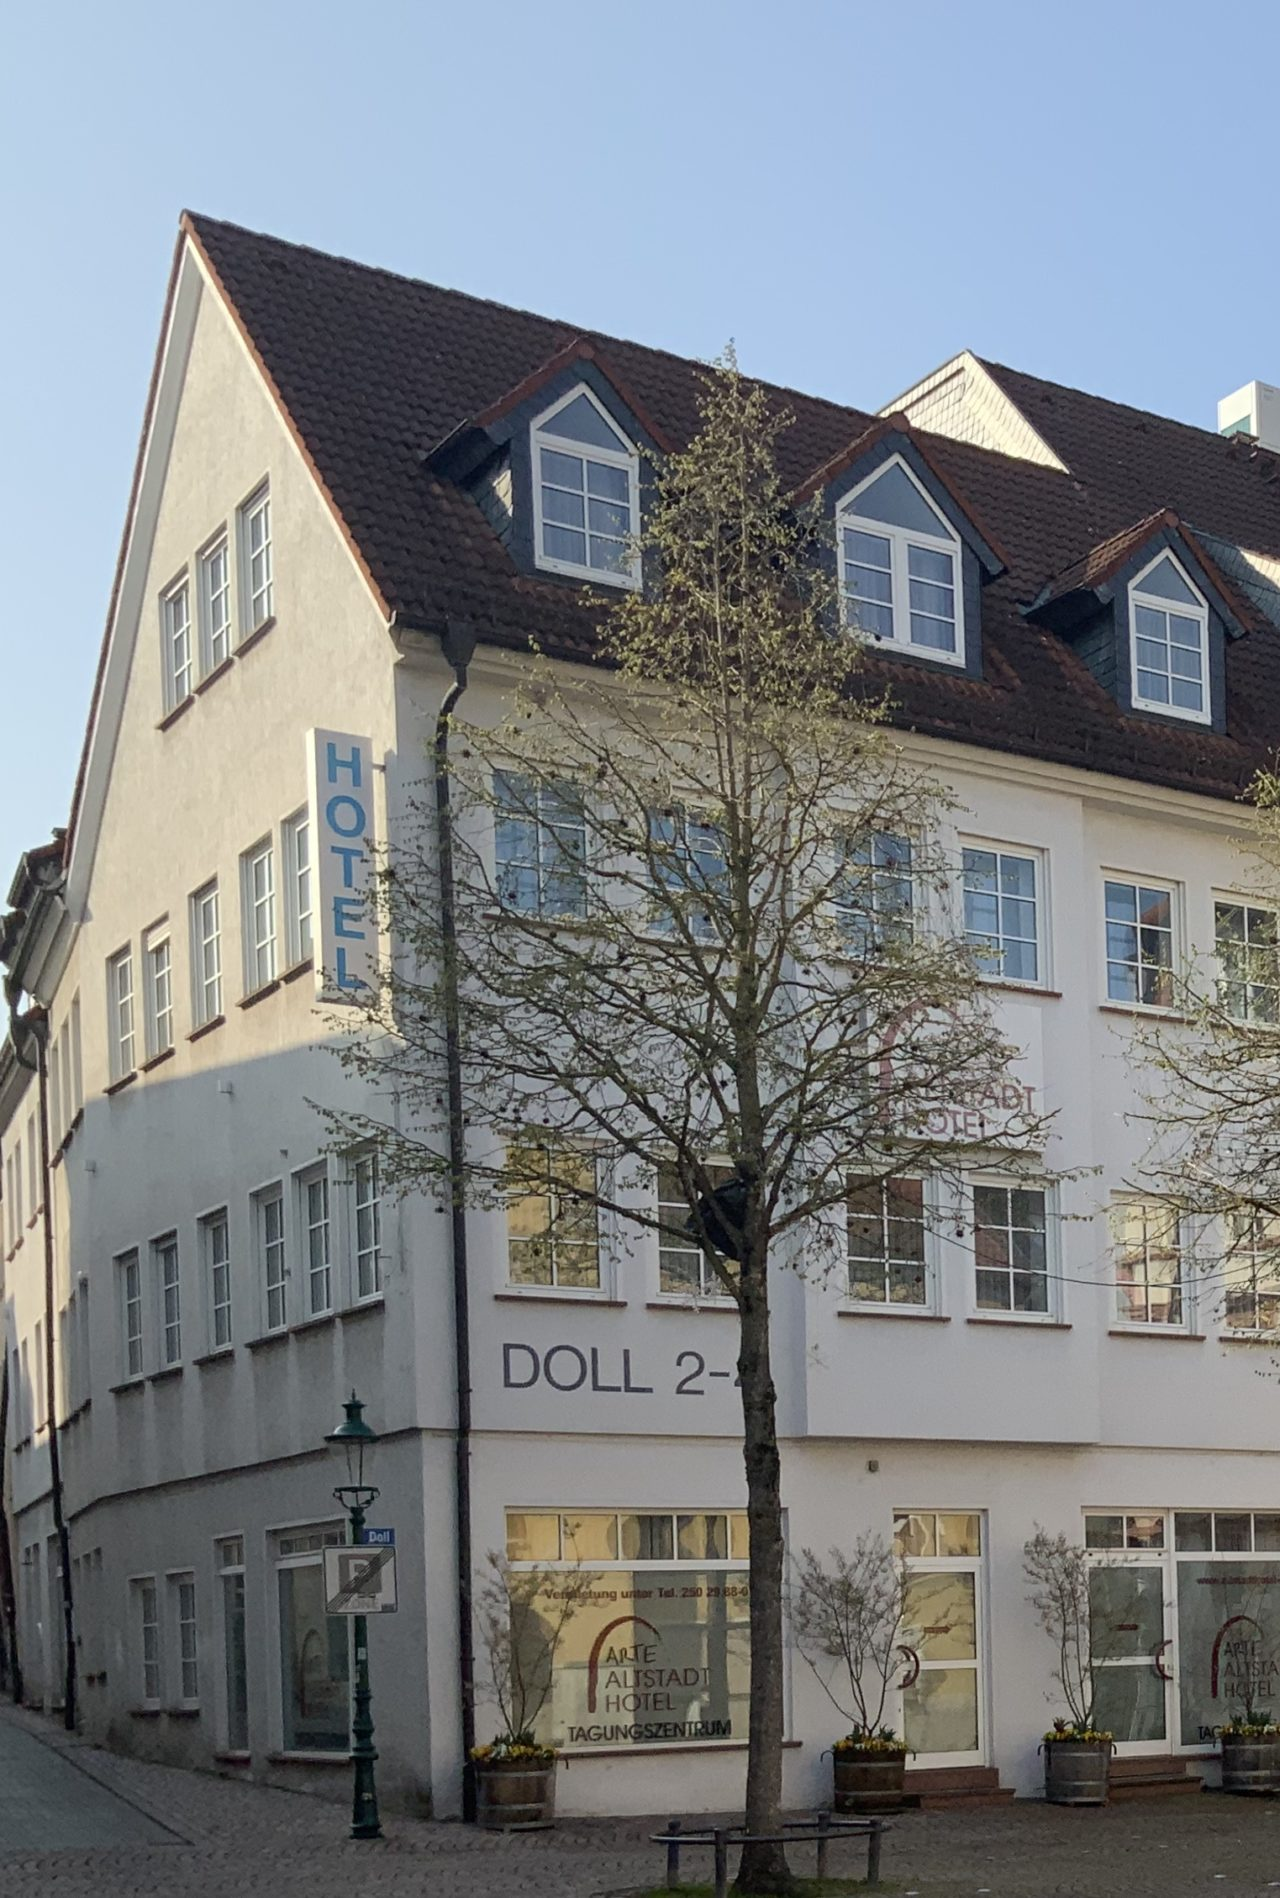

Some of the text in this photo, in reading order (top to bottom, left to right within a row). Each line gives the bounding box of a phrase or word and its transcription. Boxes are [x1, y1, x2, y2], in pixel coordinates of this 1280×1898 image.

[326, 742, 368, 990] HOTEL
[503, 1343, 742, 1396] DOLL 2-
[368, 1531, 390, 1543] Doll
[621, 1588, 653, 1599] unter
[658, 1586, 677, 1598] Tel.
[606, 1644, 657, 1666] ARTE
[605, 1667, 711, 1689] ALTSTADT
[606, 1692, 677, 1713] HOTEL
[568, 1719, 731, 1742] TAGUNGSZENTRUM
